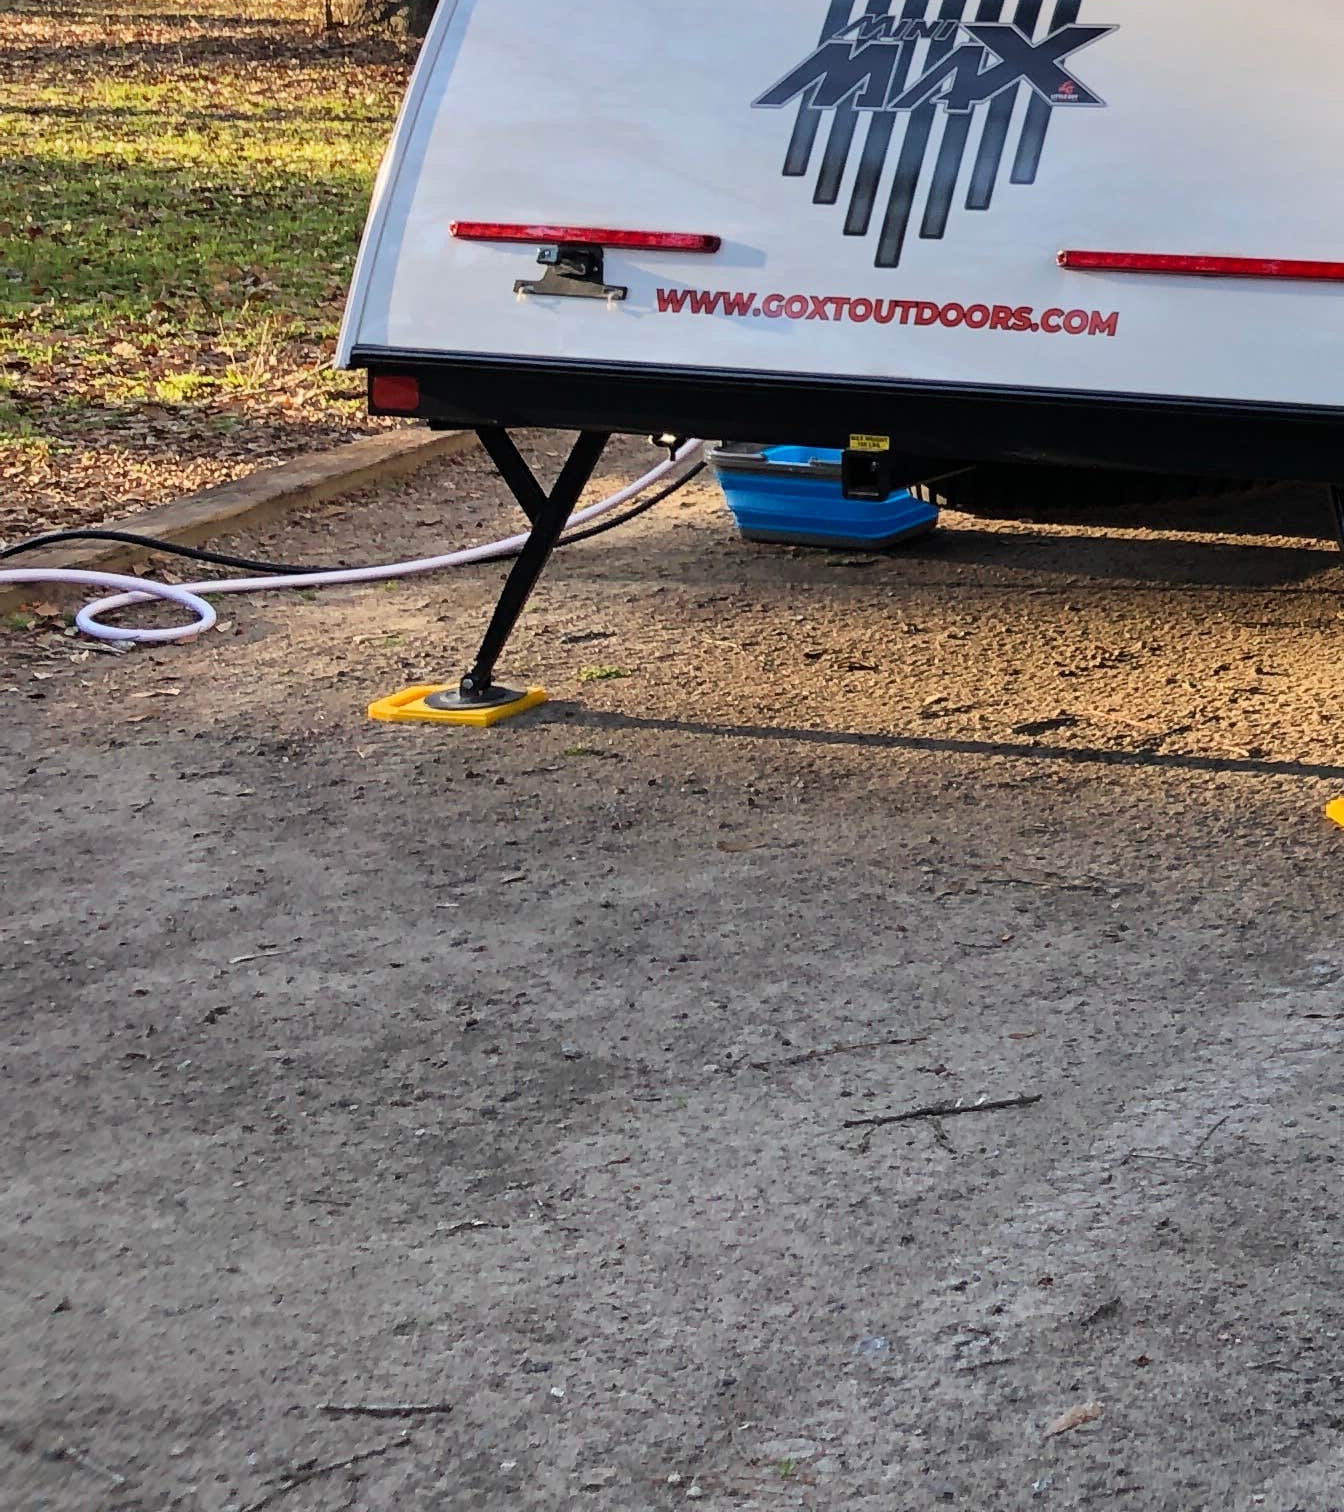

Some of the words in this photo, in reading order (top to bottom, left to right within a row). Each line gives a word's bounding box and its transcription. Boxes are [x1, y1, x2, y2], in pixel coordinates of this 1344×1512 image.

[831, 13, 958, 41] MINI
[751, 23, 1120, 113] MAX
[656, 288, 1119, 336] WWW.GOXTOUTDOORS.COM
